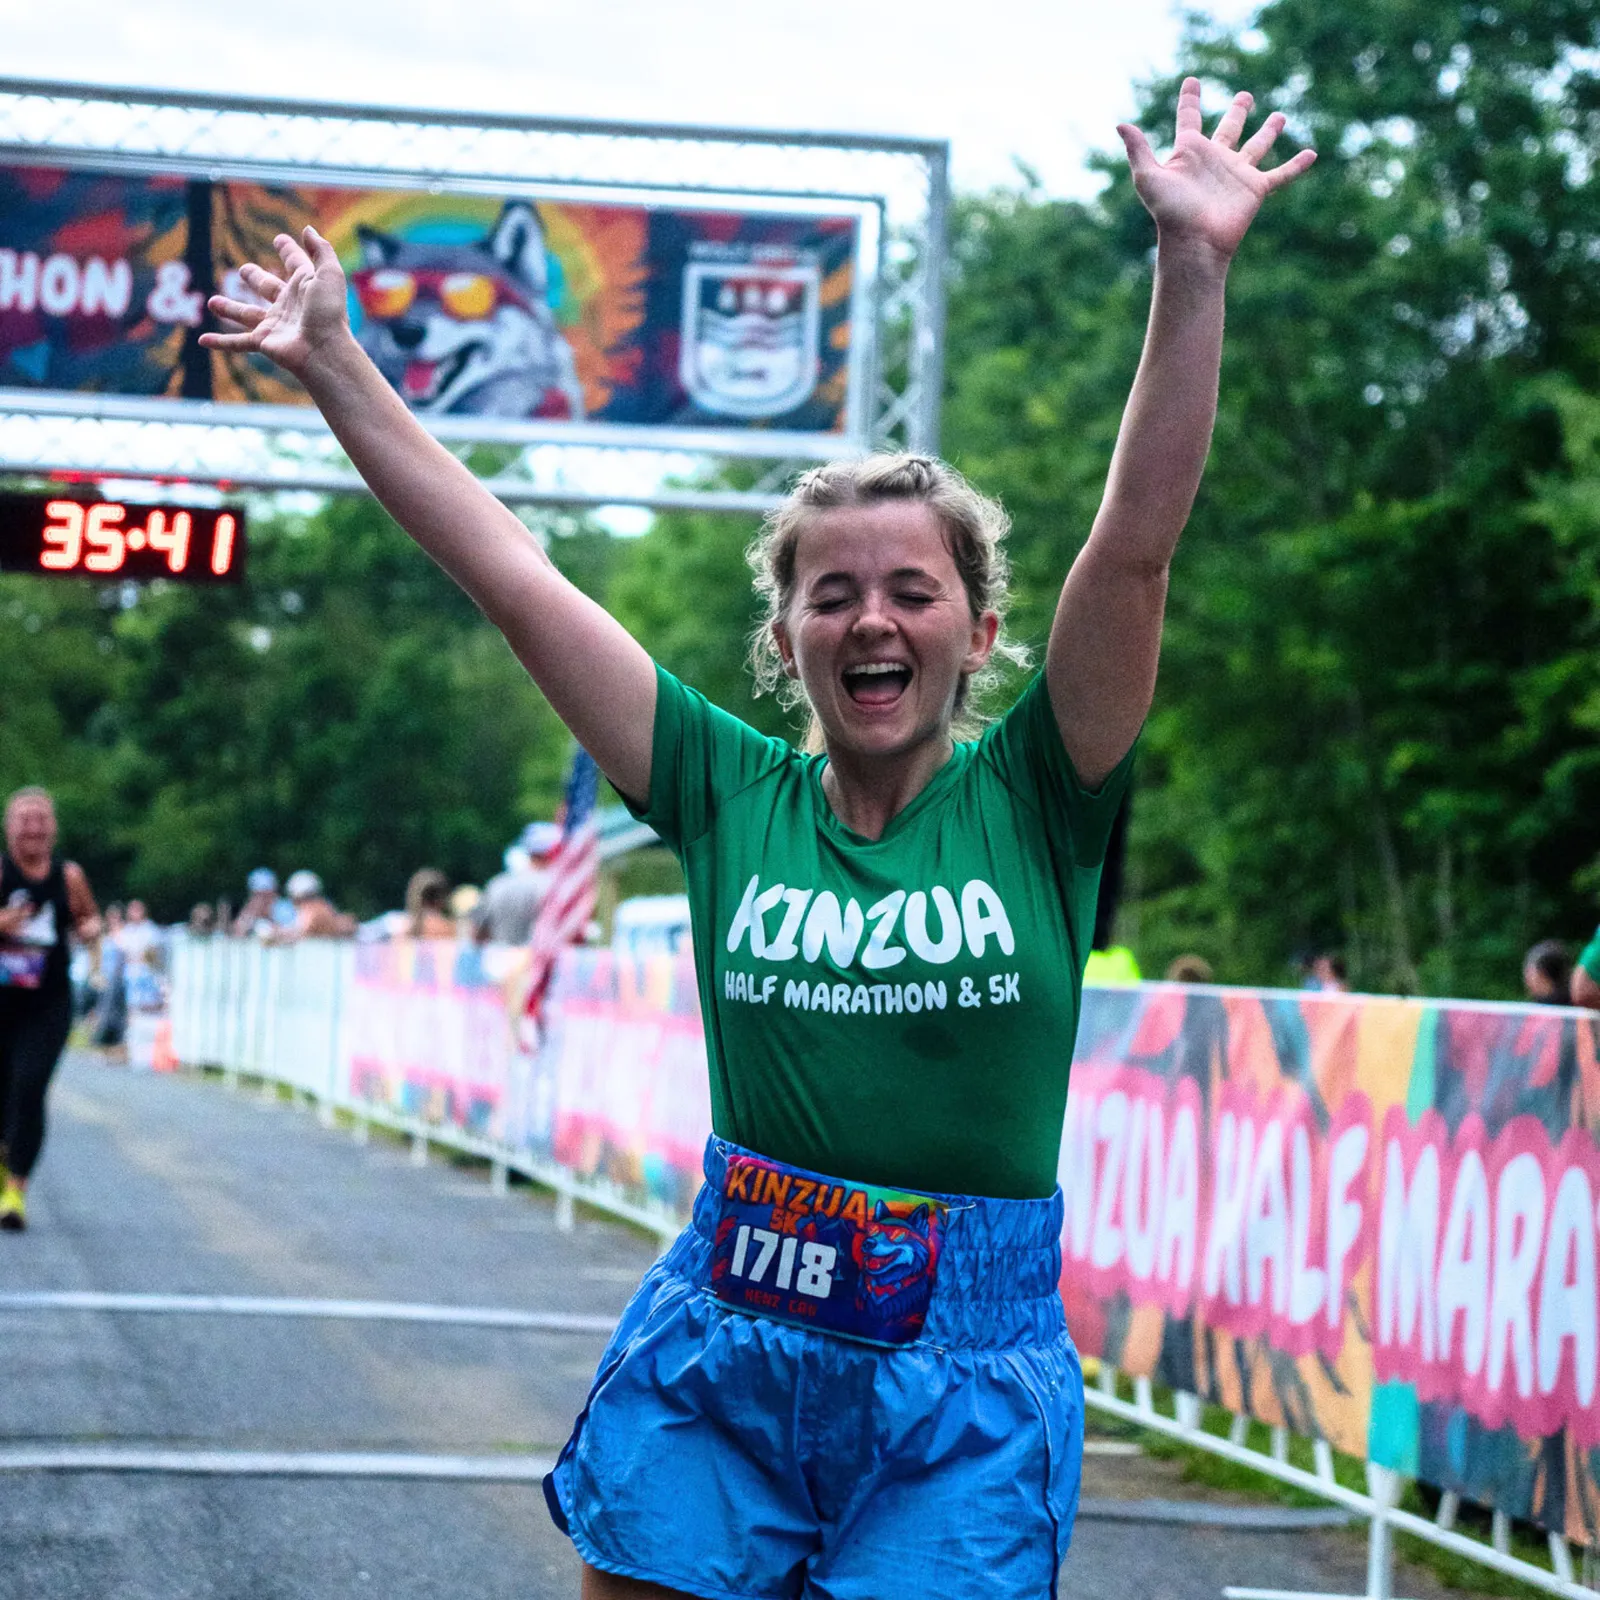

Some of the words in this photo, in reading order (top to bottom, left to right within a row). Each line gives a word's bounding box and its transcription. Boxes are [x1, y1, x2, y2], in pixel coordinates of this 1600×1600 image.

[727, 874, 1015, 969] KINZUA
[725, 970, 778, 1005] HALF
[784, 978, 947, 1014] MARATHON
[958, 976, 981, 1008] &
[989, 972, 1020, 1004] 5K
[726, 1166, 868, 1229] KINZUA
[770, 1207, 802, 1234] 5K
[730, 1225, 837, 1299] 1718
[1206, 1111, 1368, 1328] HALF
[1378, 1137, 1600, 1408] MARA
